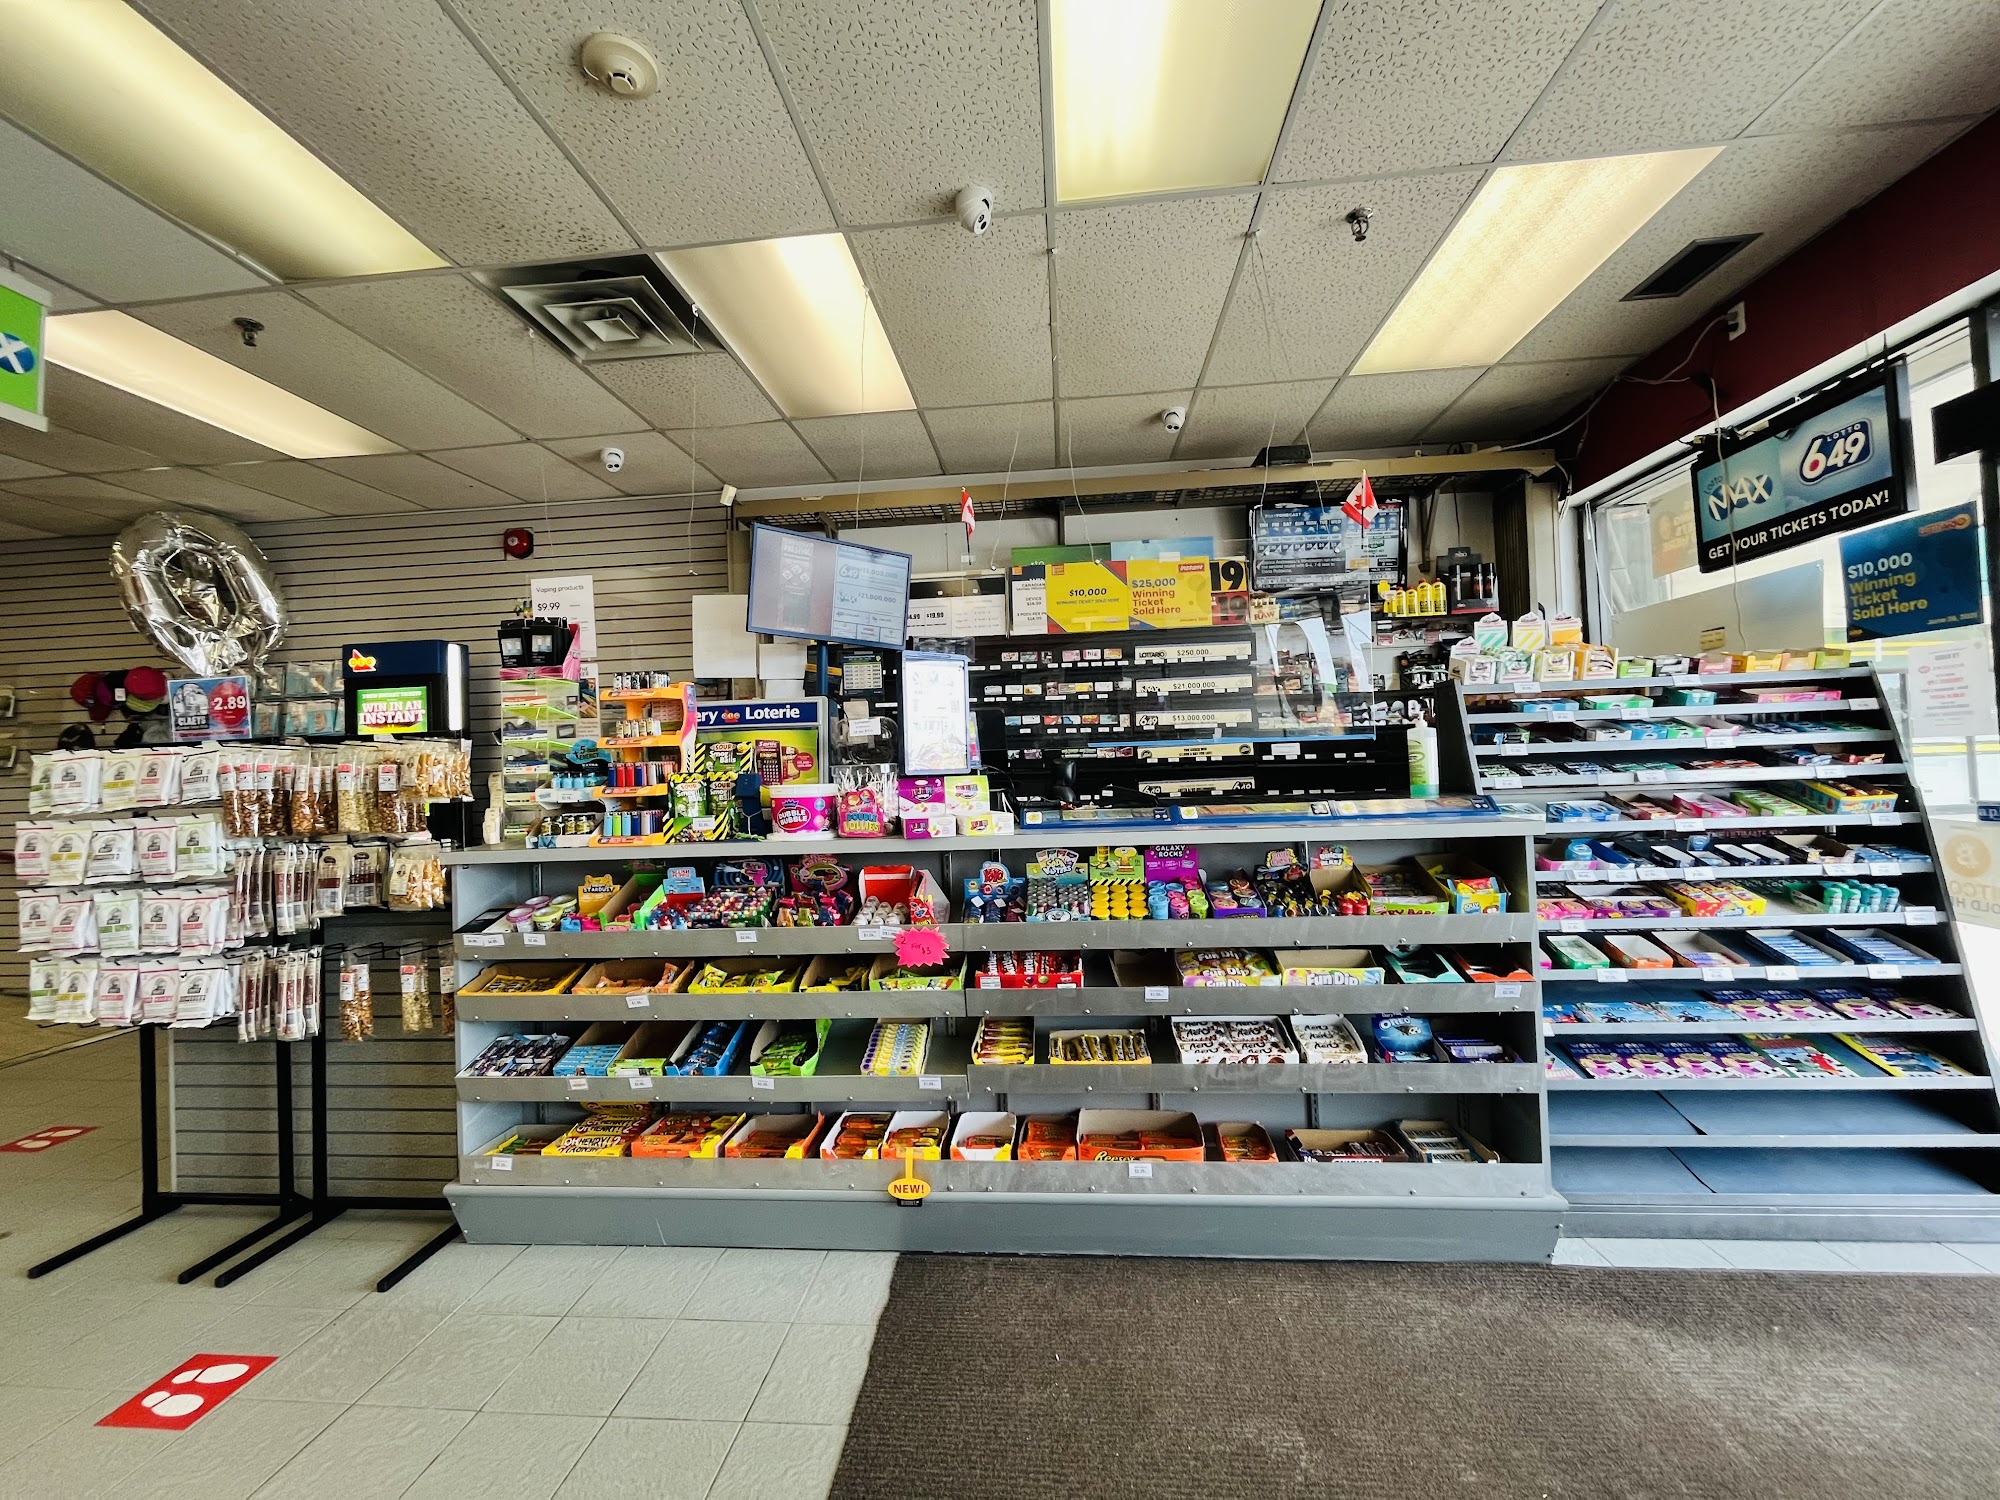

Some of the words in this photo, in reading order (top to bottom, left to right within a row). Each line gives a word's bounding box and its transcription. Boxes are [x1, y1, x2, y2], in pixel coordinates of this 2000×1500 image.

[1826, 423, 1861, 442] LOTTO
[1801, 431, 1867, 480] 649
[1708, 473, 1770, 521] MAX
[1708, 542, 1731, 560] GET
[1733, 530, 1768, 551] YOUR
[1770, 511, 1827, 540] TICKETS
[1829, 490, 1889, 521] TODAY!
[1848, 552, 1913, 580] $10,000
[1210, 561, 1244, 591] 19
[1132, 578, 1176, 589] $25,000
[1851, 572, 1916, 594] Winning
[1070, 588, 1107, 598] $10,000
[1132, 589, 1175, 600] Winning
[1851, 588, 1898, 608] Ticket
[538, 602, 560, 612] $9.99
[1133, 598, 1164, 607] Ticket
[1133, 607, 1155, 616] Sold
[1157, 606, 1181, 615] Here
[1852, 606, 1885, 621] Sold
[1888, 598, 1928, 615] Here
[1254, 611, 1275, 620] RAW
[1139, 651, 1166, 659] LOTTARIO
[362, 702, 387, 713] WIN
[389, 701, 403, 712] IN
[405, 700, 422, 712] AN
[358, 710, 426, 725] INSTANT
[746, 705, 800, 720] Loterie
[1140, 715, 1158, 727] 649
[580, 746, 586, 754] 5
[778, 809, 806, 820] DUBBLE
[846, 813, 878, 821] DOUBLE
[780, 816, 808, 826] BUBBLE
[1155, 844, 1186, 852] GALAXY
[901, 936, 907, 945] 2
[922, 947, 932, 955] $3
[1198, 952, 1221, 961] Fun
[1222, 951, 1242, 960] Dip
[1203, 968, 1226, 978] Fun
[1227, 968, 1250, 977] Dip
[1306, 973, 1333, 986] Fun
[1334, 972, 1360, 986] Dip
[1379, 1016, 1411, 1031] OREO
[564, 1138, 579, 1147] OH
[579, 1136, 610, 1147] HENRY!
[1095, 1151, 1136, 1161] Reese's
[894, 1184, 925, 1194] NEW!
